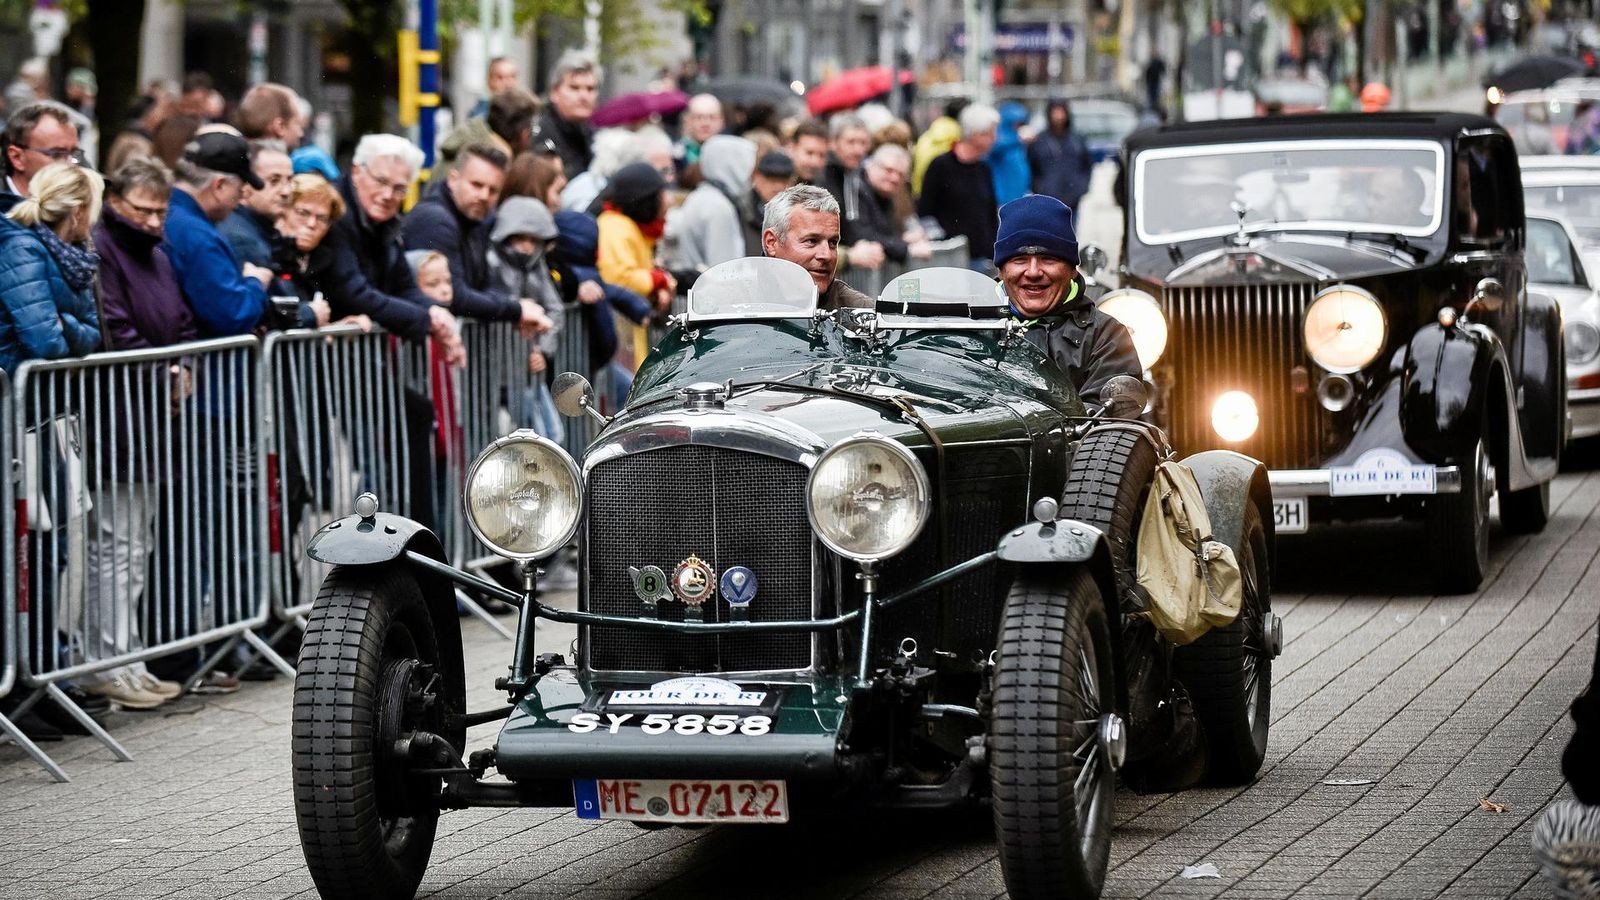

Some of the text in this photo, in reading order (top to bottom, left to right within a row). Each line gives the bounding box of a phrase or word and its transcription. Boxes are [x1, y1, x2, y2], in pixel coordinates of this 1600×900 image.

[1334, 471, 1377, 482] TOUR
[1384, 470, 1405, 480] DE
[613, 691, 682, 700] TOUR
[694, 691, 727, 700] DE
[567, 713, 772, 736] SY 5858
[583, 780, 781, 817] D ME 07122
